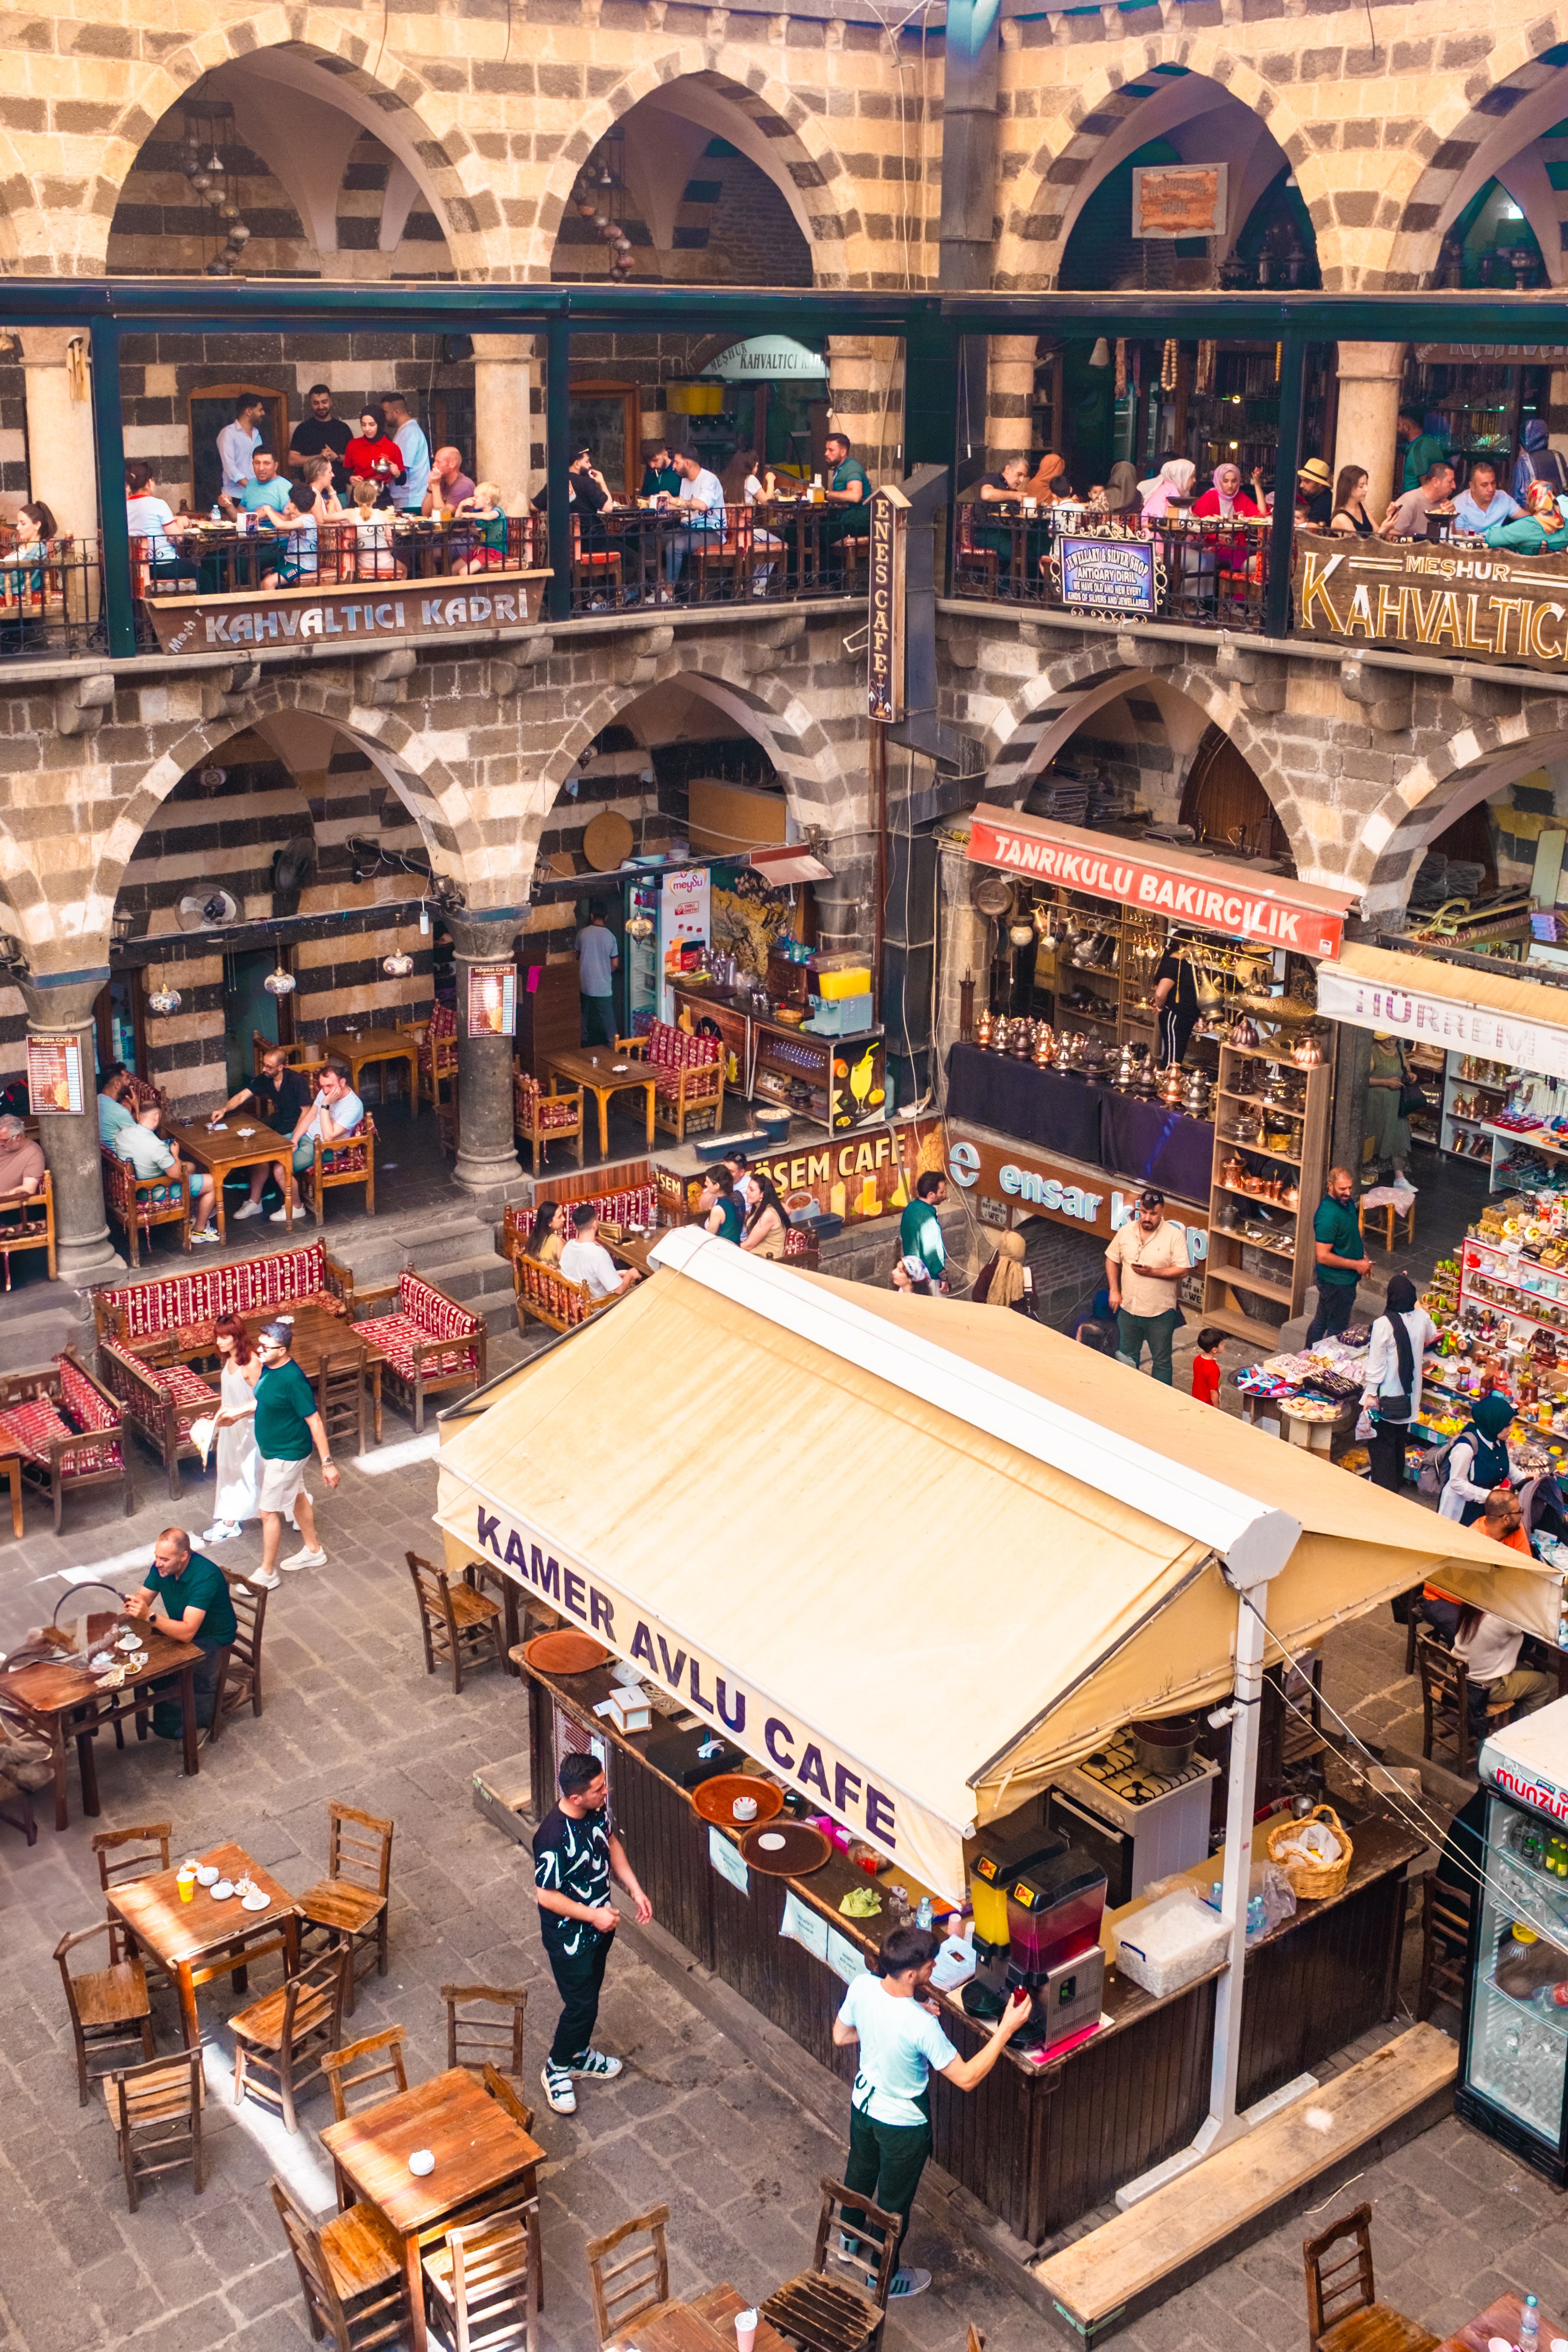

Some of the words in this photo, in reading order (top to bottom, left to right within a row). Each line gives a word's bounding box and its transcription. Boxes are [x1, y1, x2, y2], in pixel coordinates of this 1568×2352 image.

[710, 343, 747, 373] MEŞHUR
[740, 354, 798, 369] KAHVALTICI
[873, 499, 892, 585] ENES
[1065, 547, 1101, 572] JEWELLARY
[1101, 547, 1107, 563] &
[1129, 555, 1149, 578] SHOP
[1073, 580, 1080, 590] WE
[1081, 582, 1093, 592] HAVE
[1094, 583, 1103, 593] OLD
[1104, 584, 1114, 594] AND
[1115, 585, 1126, 595] NEW
[1127, 586, 1142, 597] EVERY
[1406, 555, 1511, 582] MEŞHUR
[206, 602, 405, 644] KAHVALTICI
[421, 588, 528, 626] KADRİ
[1082, 593, 1088, 602] OF
[1107, 596, 1117, 605] AND
[872, 589, 890, 674] CAFE
[995, 835, 1134, 895] TANRIKULU
[1139, 873, 1301, 943] BAKIRCILIK
[839, 1134, 906, 1177] CAFE
[999, 1164, 1103, 1223] ensar
[477, 1504, 617, 1643] KAMER
[630, 1620, 746, 1733] AVLU
[764, 1717, 897, 1850] CAFE
